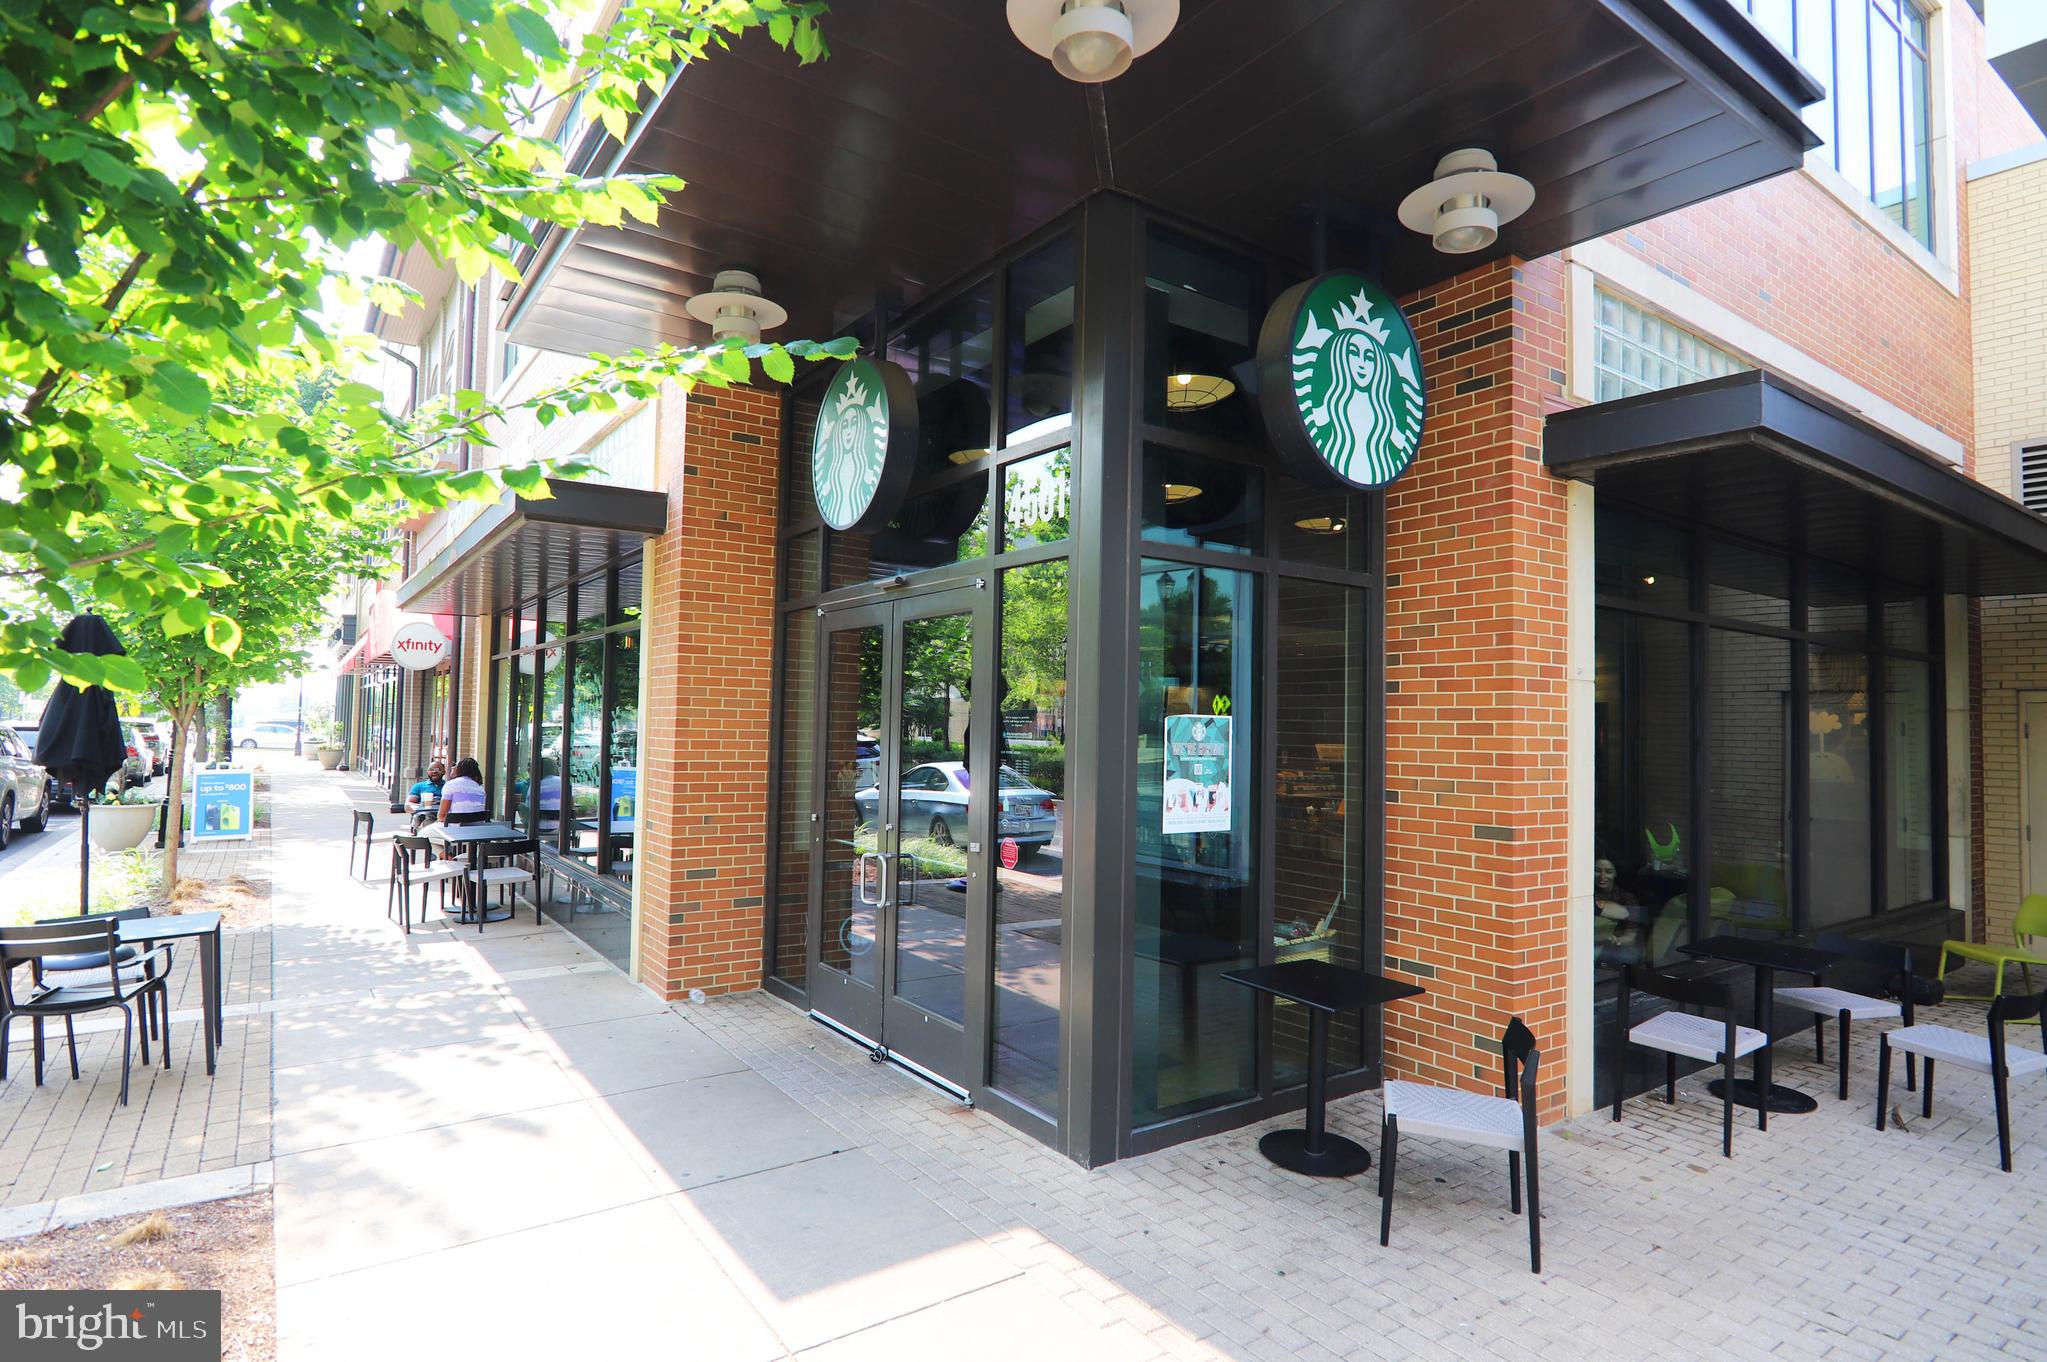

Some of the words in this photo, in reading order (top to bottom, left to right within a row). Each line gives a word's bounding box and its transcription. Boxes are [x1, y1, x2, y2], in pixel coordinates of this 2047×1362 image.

[1007, 470, 1066, 529] 4501
[396, 638, 442, 654] xfinity
[200, 785, 212, 793] up
[213, 784, 225, 792] to
